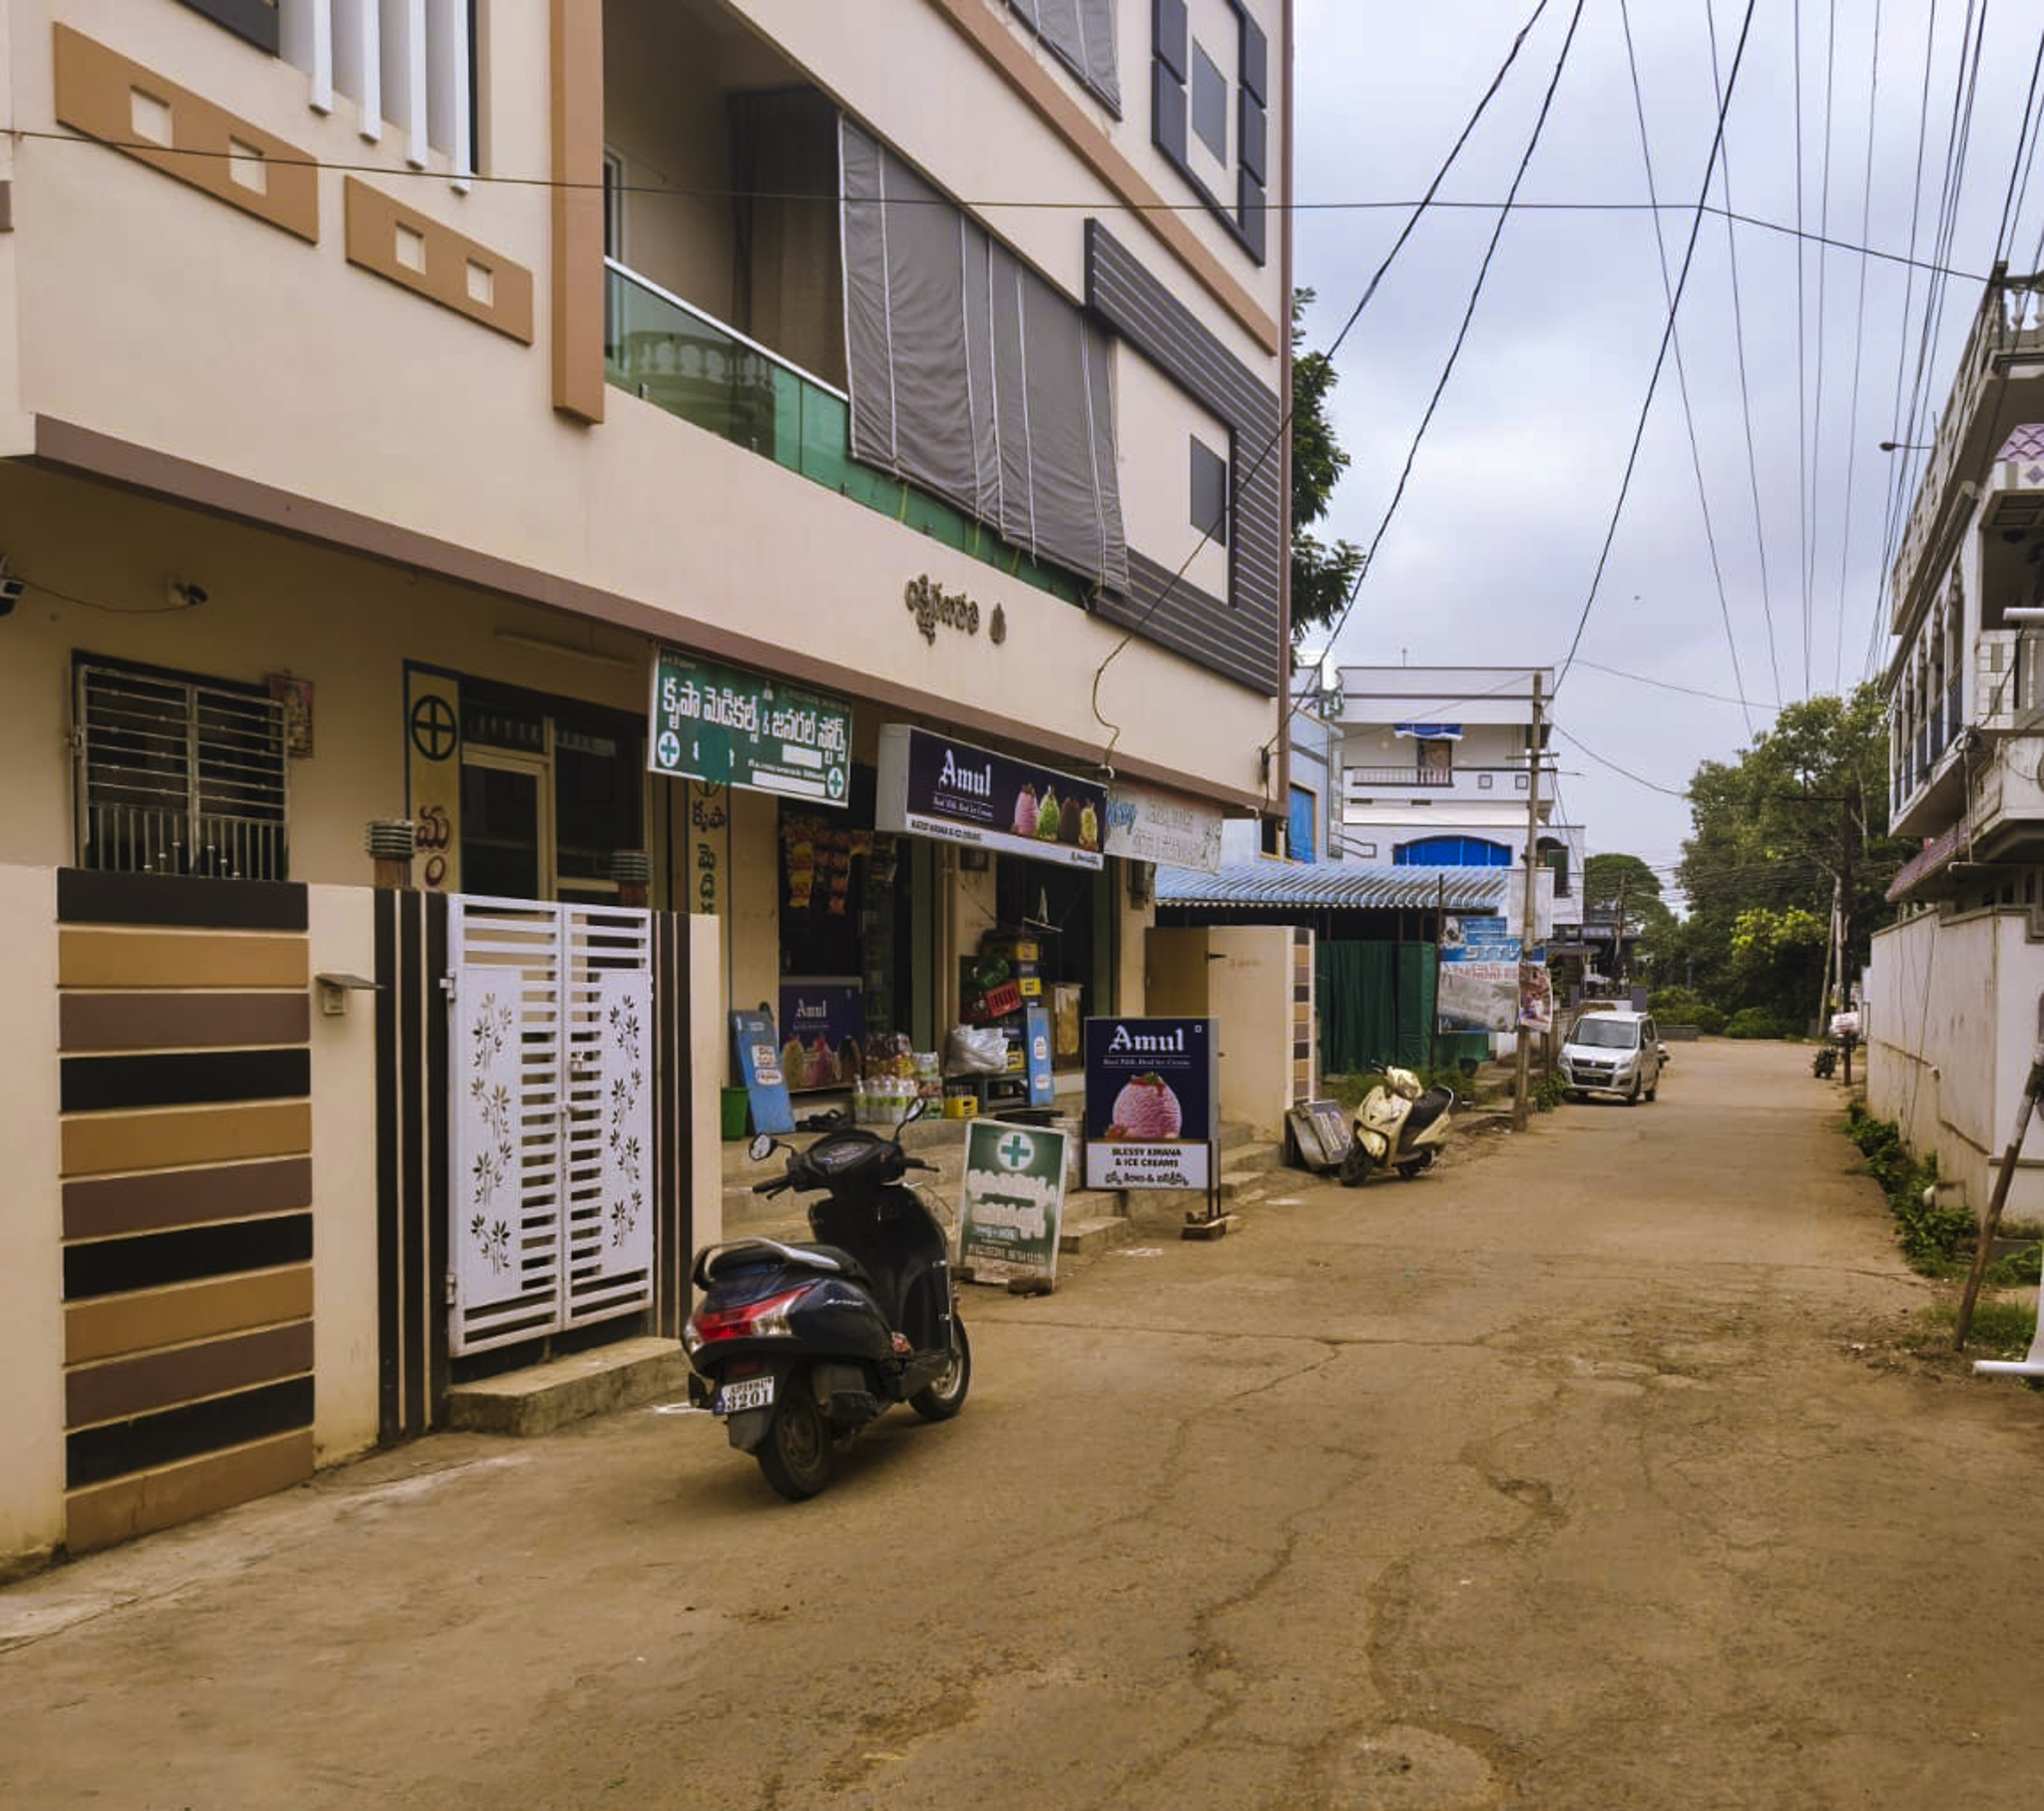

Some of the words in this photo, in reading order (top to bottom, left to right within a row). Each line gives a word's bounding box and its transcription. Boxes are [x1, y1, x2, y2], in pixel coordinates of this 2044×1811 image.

[938, 748, 991, 796] Amul
[794, 998, 827, 1019] Amul
[1109, 1025, 1185, 1053] Amul
[1141, 1158, 1179, 1167] CREAMS
